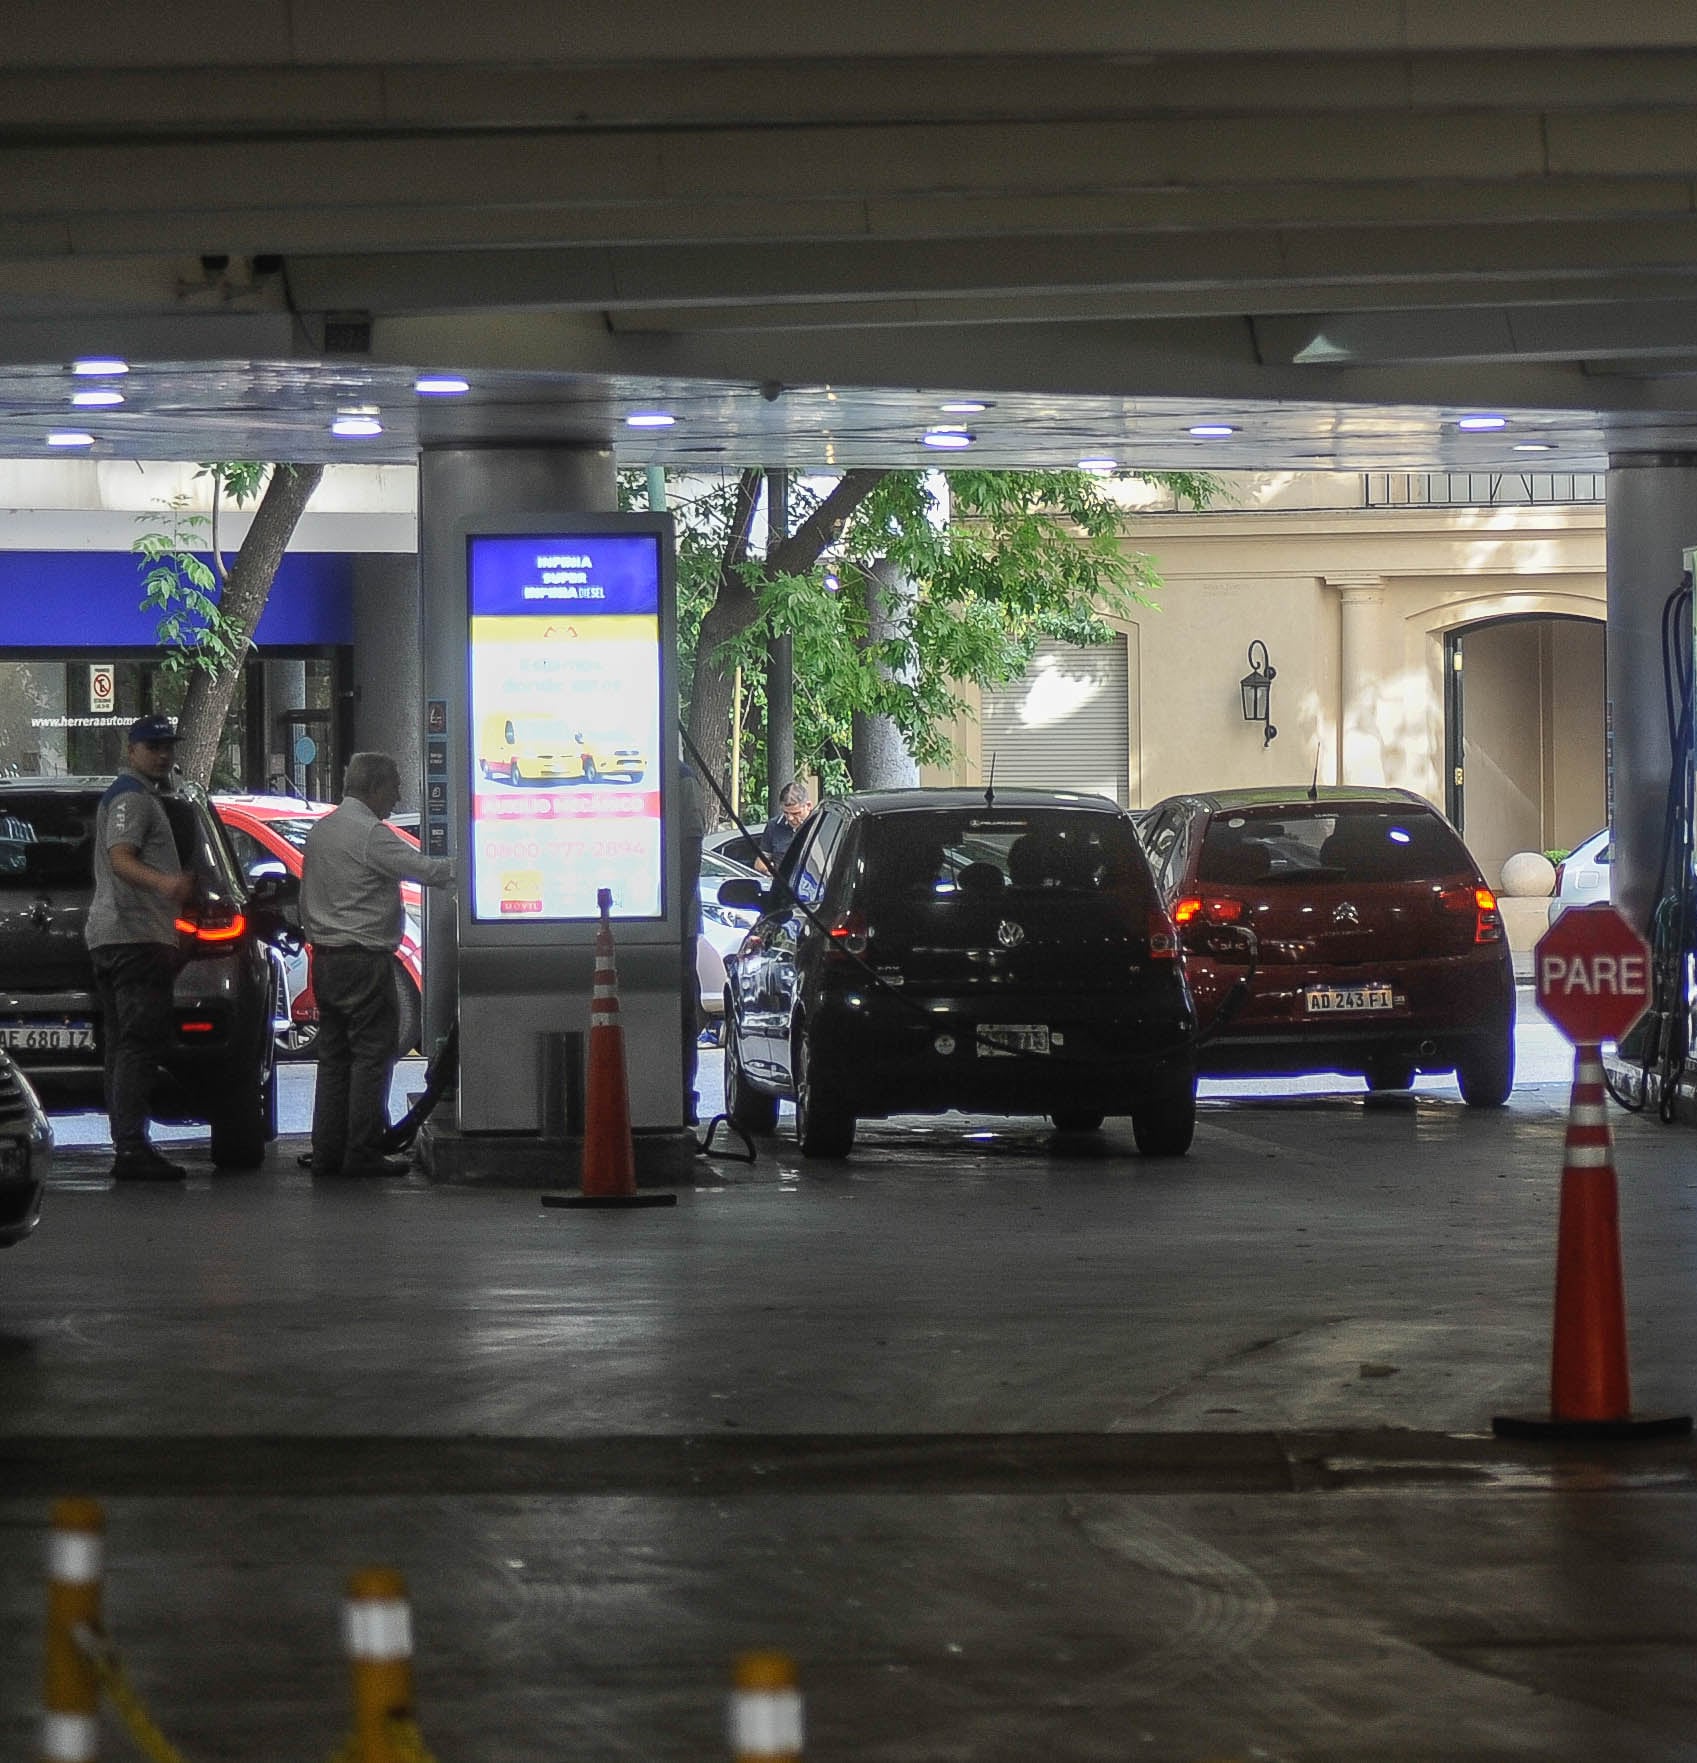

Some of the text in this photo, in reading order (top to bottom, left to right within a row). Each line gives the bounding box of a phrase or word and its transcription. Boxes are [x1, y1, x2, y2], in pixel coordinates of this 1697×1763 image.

[1543, 956, 1646, 995] PARE
[1311, 995, 1331, 1010] AD
[1335, 993, 1364, 1009] 243
[26, 1031, 60, 1048] 680
